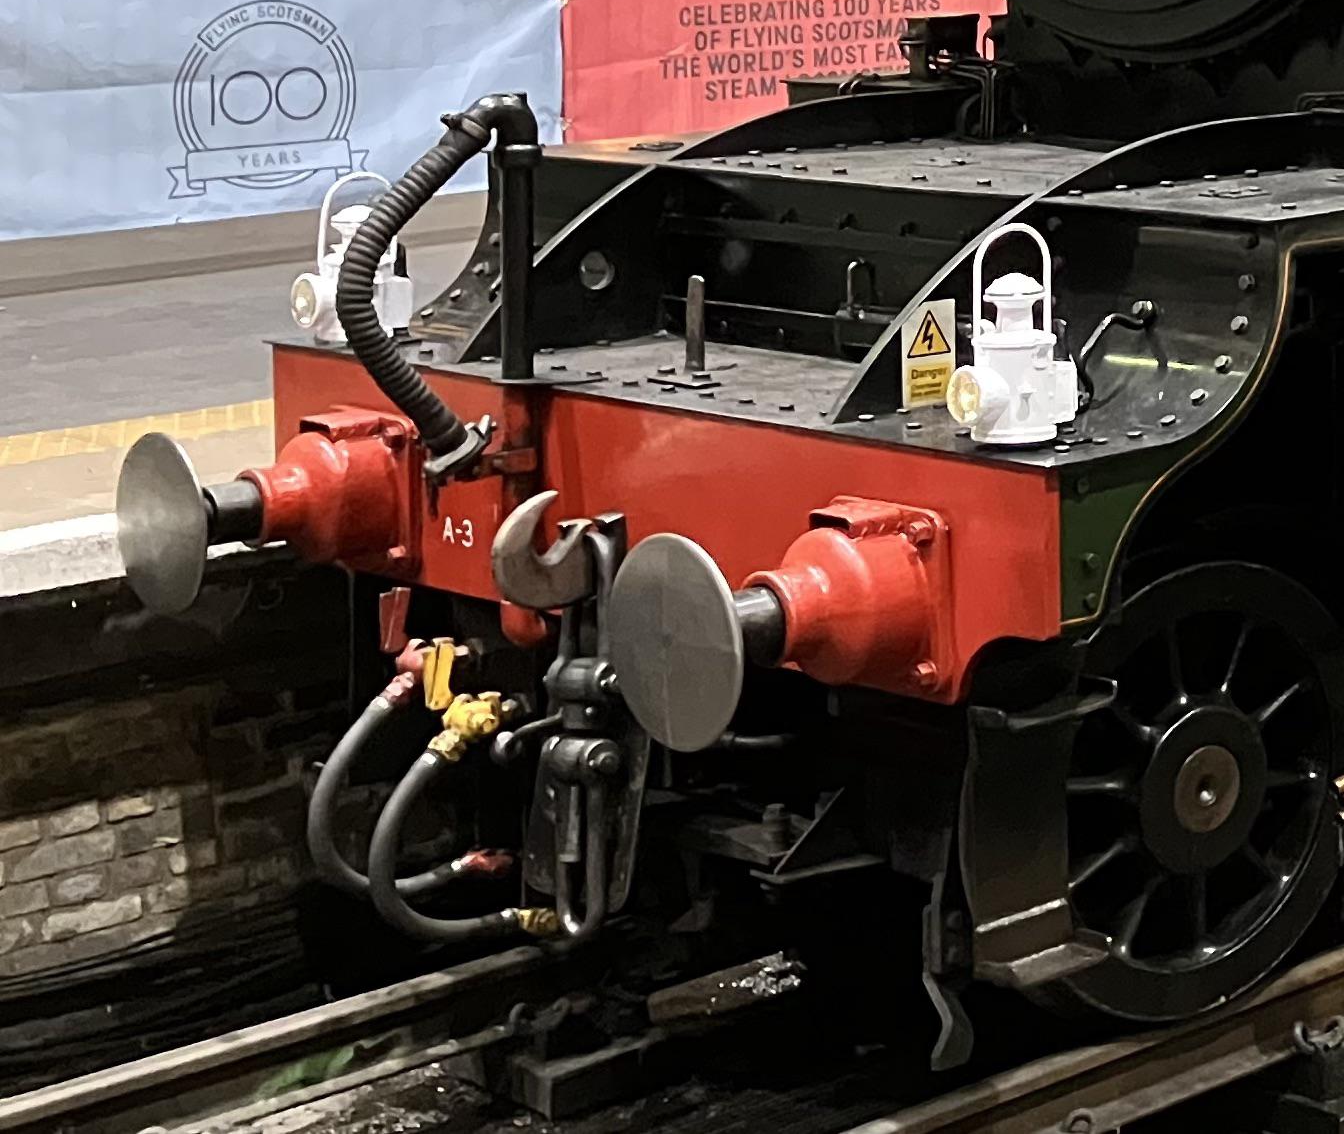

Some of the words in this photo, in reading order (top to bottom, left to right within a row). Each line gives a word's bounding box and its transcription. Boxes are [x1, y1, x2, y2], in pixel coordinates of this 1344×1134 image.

[206, 10, 250, 44] FLYING
[257, 5, 328, 36] SCOTSMAN
[694, 29, 722, 51] OF
[730, 23, 804, 49] FLYING
[812, 17, 909, 43] SCOTSMA
[660, 56, 701, 79] THE
[707, 49, 804, 75] WORLD'S
[813, 43, 868, 66] MOST
[210, 66, 327, 126] 100
[705, 76, 778, 101] STEAM
[237, 149, 303, 168] YEARS
[911, 367, 947, 379] Danger
[442, 516, 474, 548] A-3
